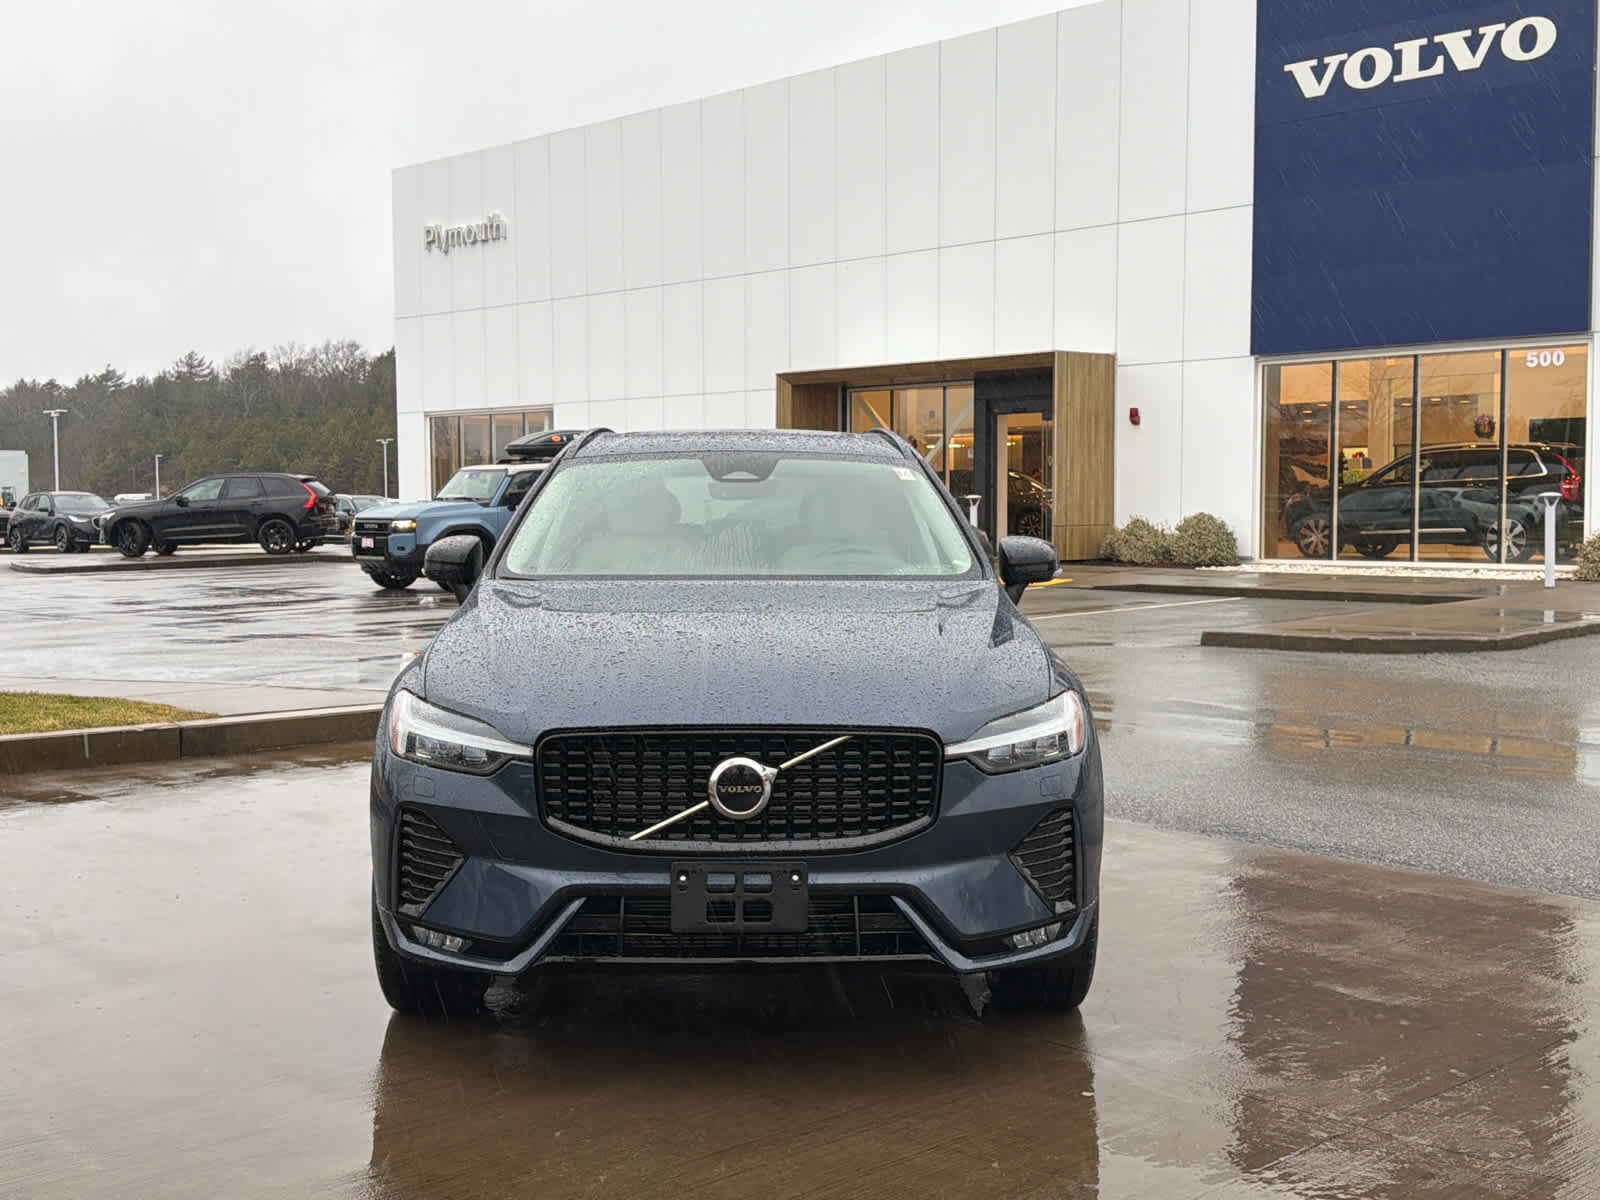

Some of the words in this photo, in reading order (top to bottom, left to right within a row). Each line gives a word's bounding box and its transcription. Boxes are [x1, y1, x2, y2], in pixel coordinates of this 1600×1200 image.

[1283, 16, 1557, 98] VOLVO
[424, 212, 507, 255] Plymouth
[1525, 350, 1565, 368] 500
[718, 785, 762, 793] VOLVO
